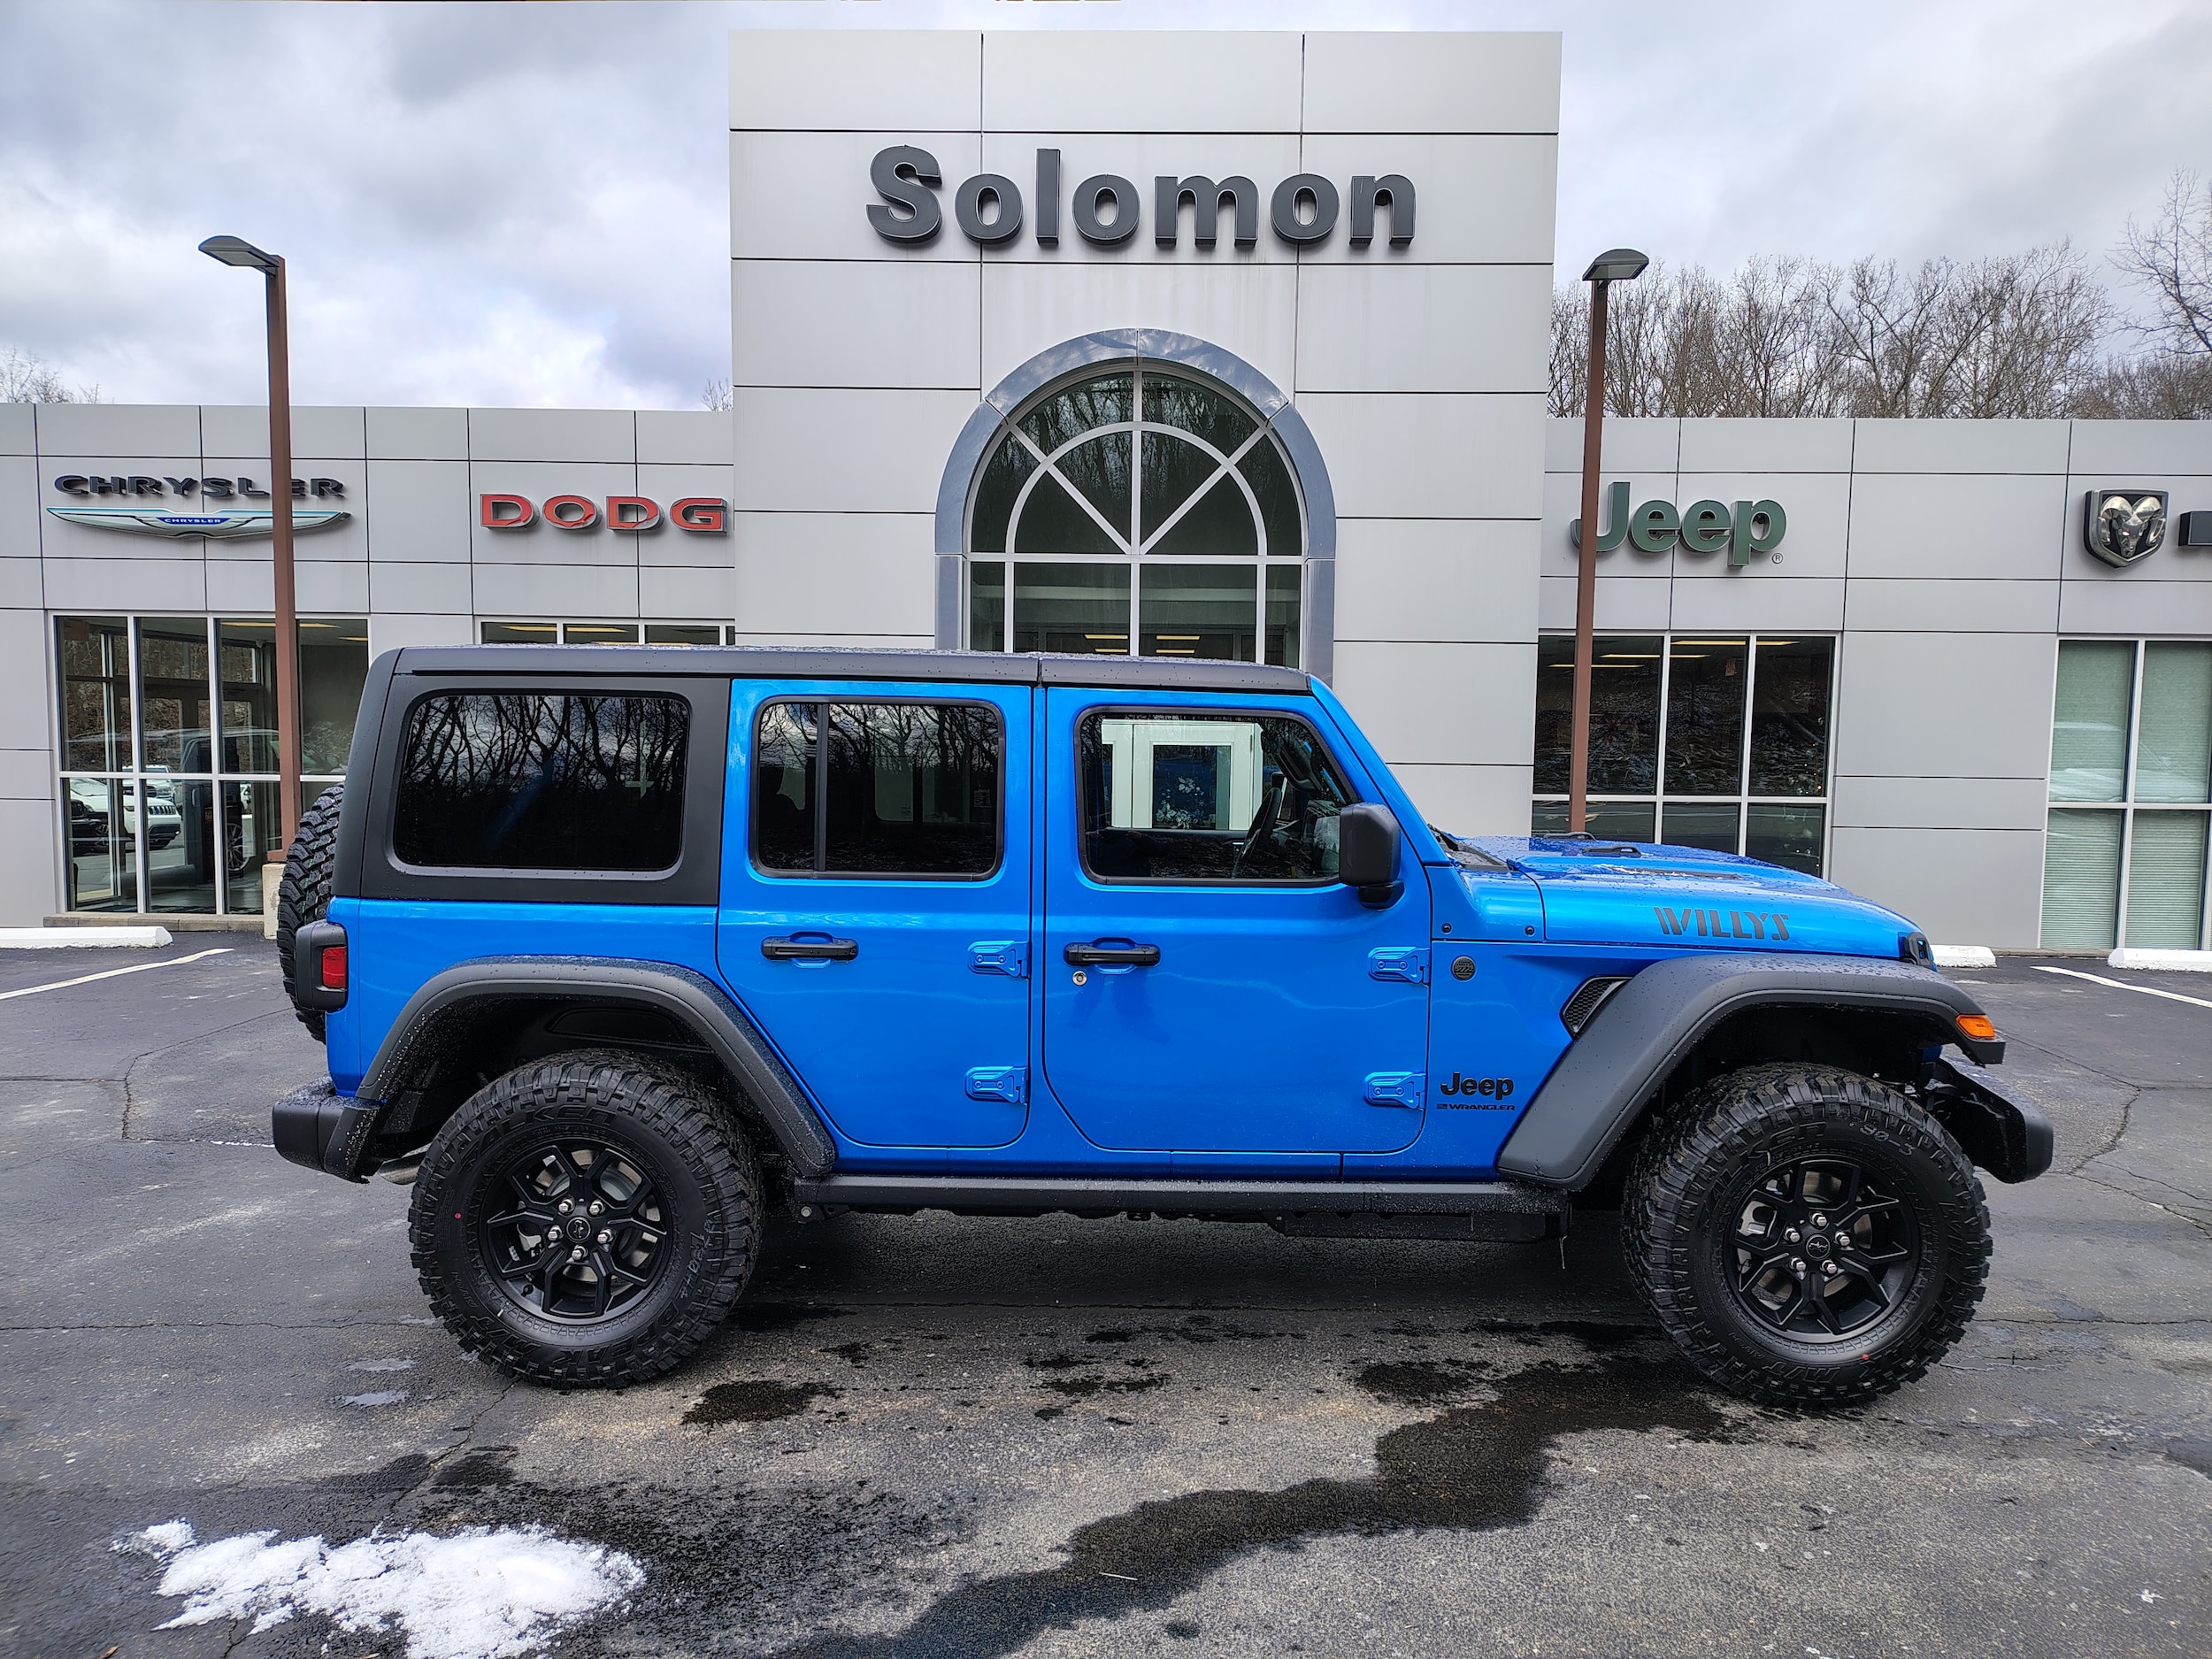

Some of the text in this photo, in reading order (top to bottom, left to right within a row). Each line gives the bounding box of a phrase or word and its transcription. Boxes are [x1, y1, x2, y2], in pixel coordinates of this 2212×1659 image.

[866, 145, 1417, 246] Solomon
[1571, 481, 1786, 567] Jeep
[1653, 906, 1790, 941] WILLYS
[1440, 1071, 1514, 1101] Jeep
